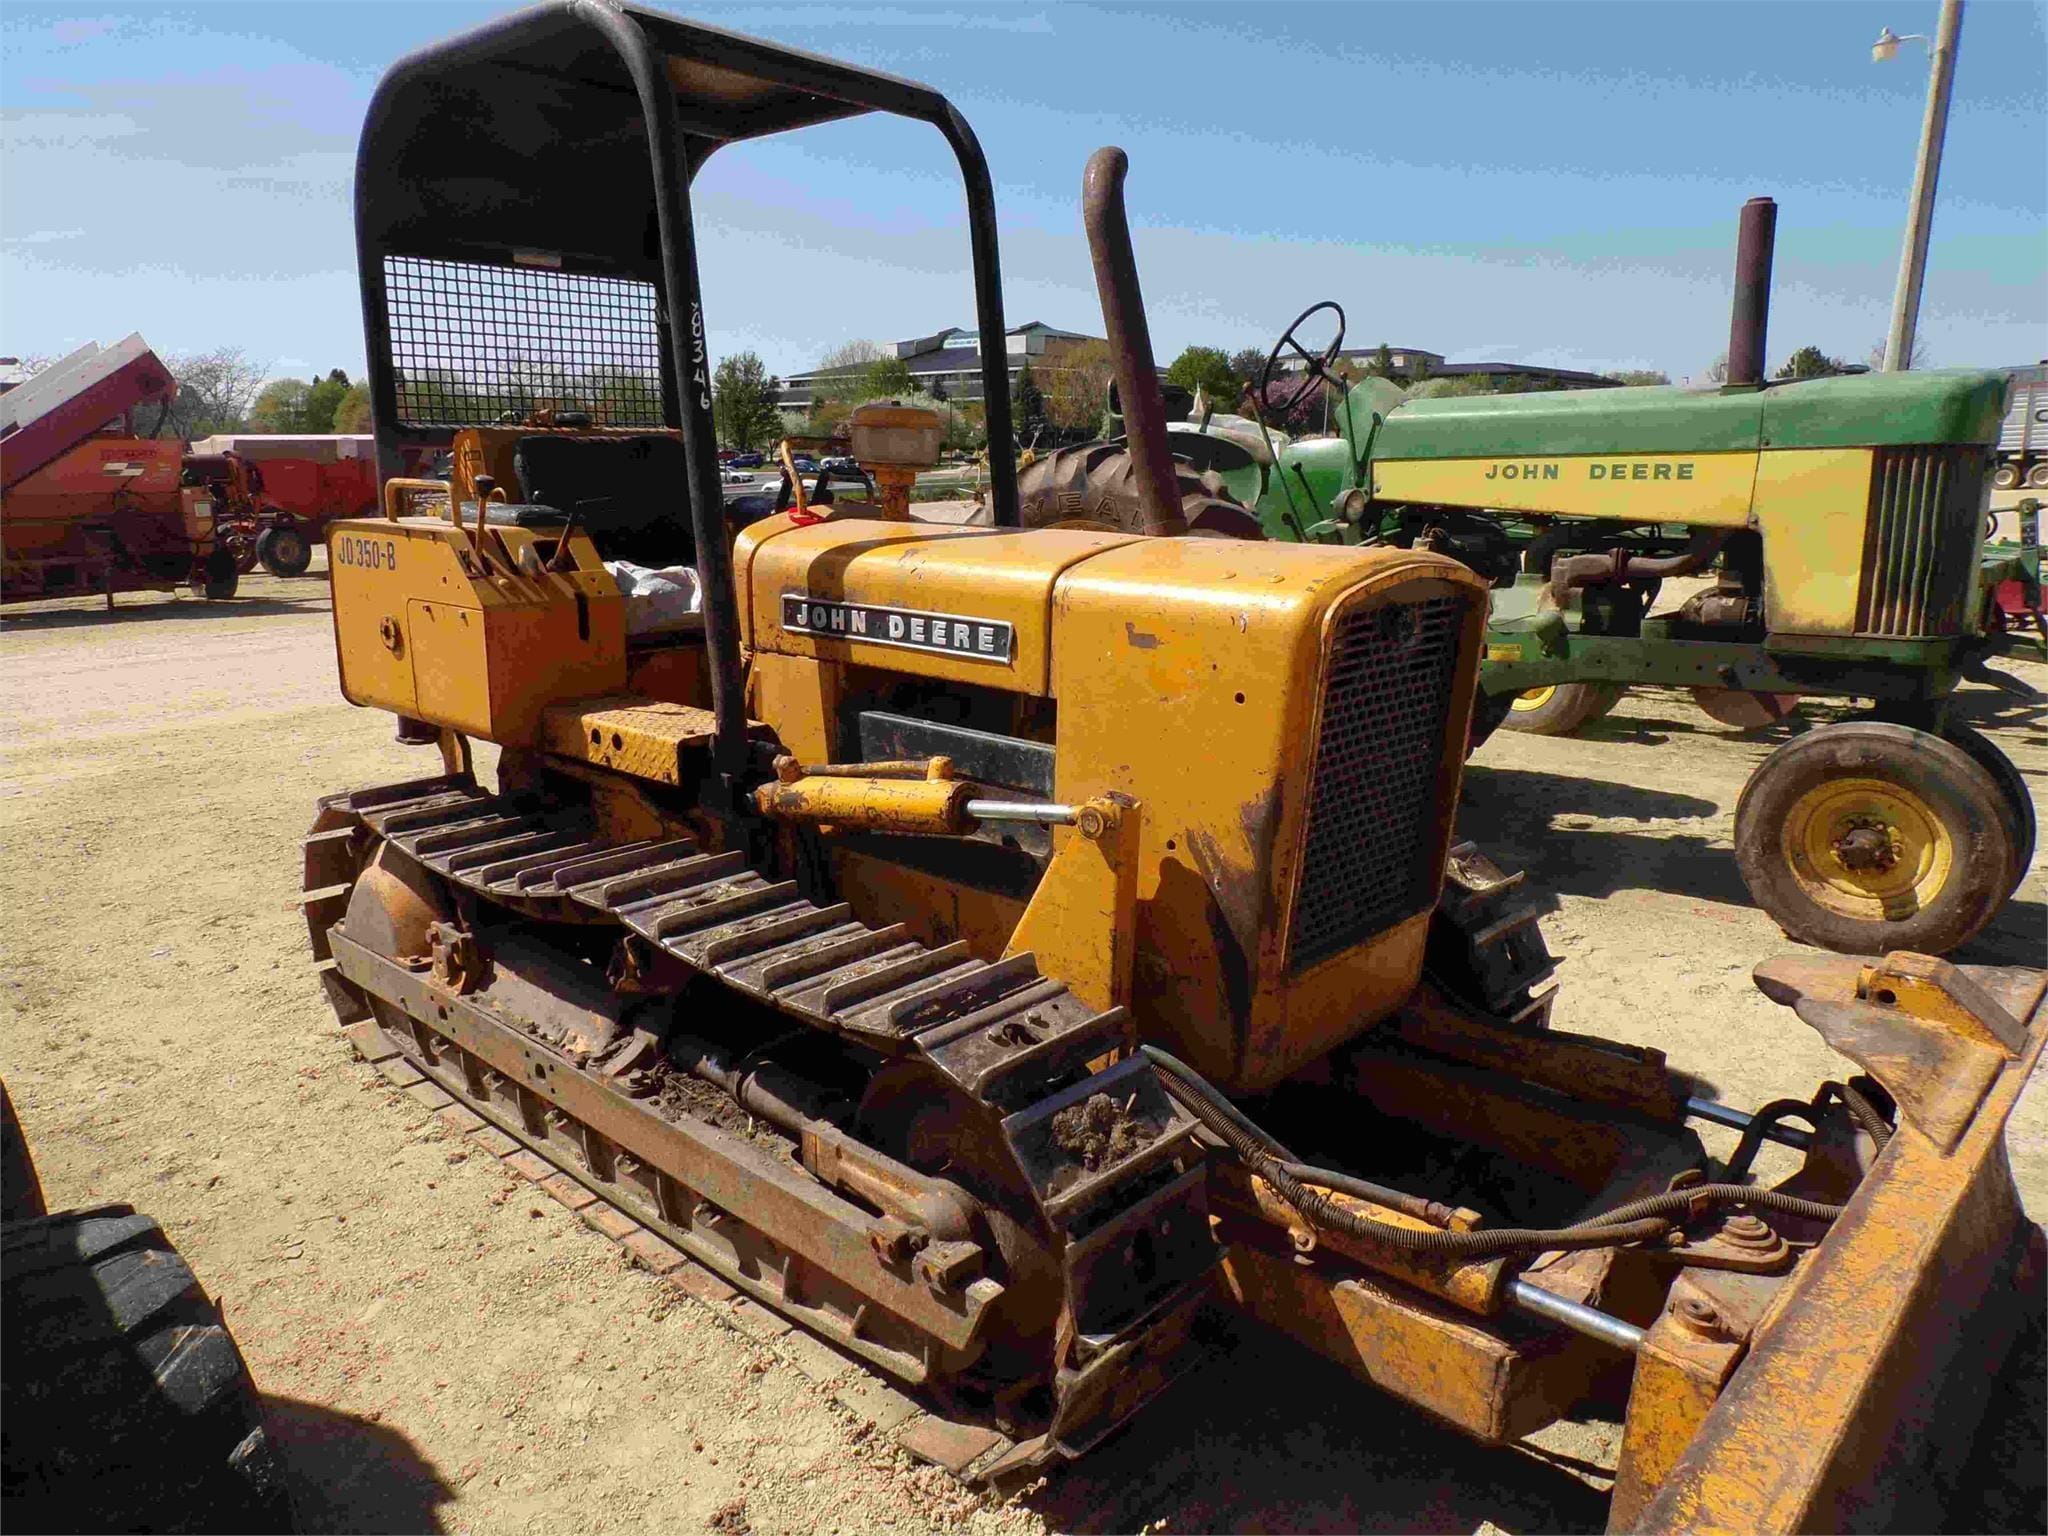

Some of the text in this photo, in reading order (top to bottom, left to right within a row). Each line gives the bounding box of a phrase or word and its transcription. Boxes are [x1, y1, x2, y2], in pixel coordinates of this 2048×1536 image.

[1485, 463, 1695, 480] JOHN DEERE
[339, 536, 396, 571] JD 350-B
[797, 603, 995, 652] JOHN DEERE
